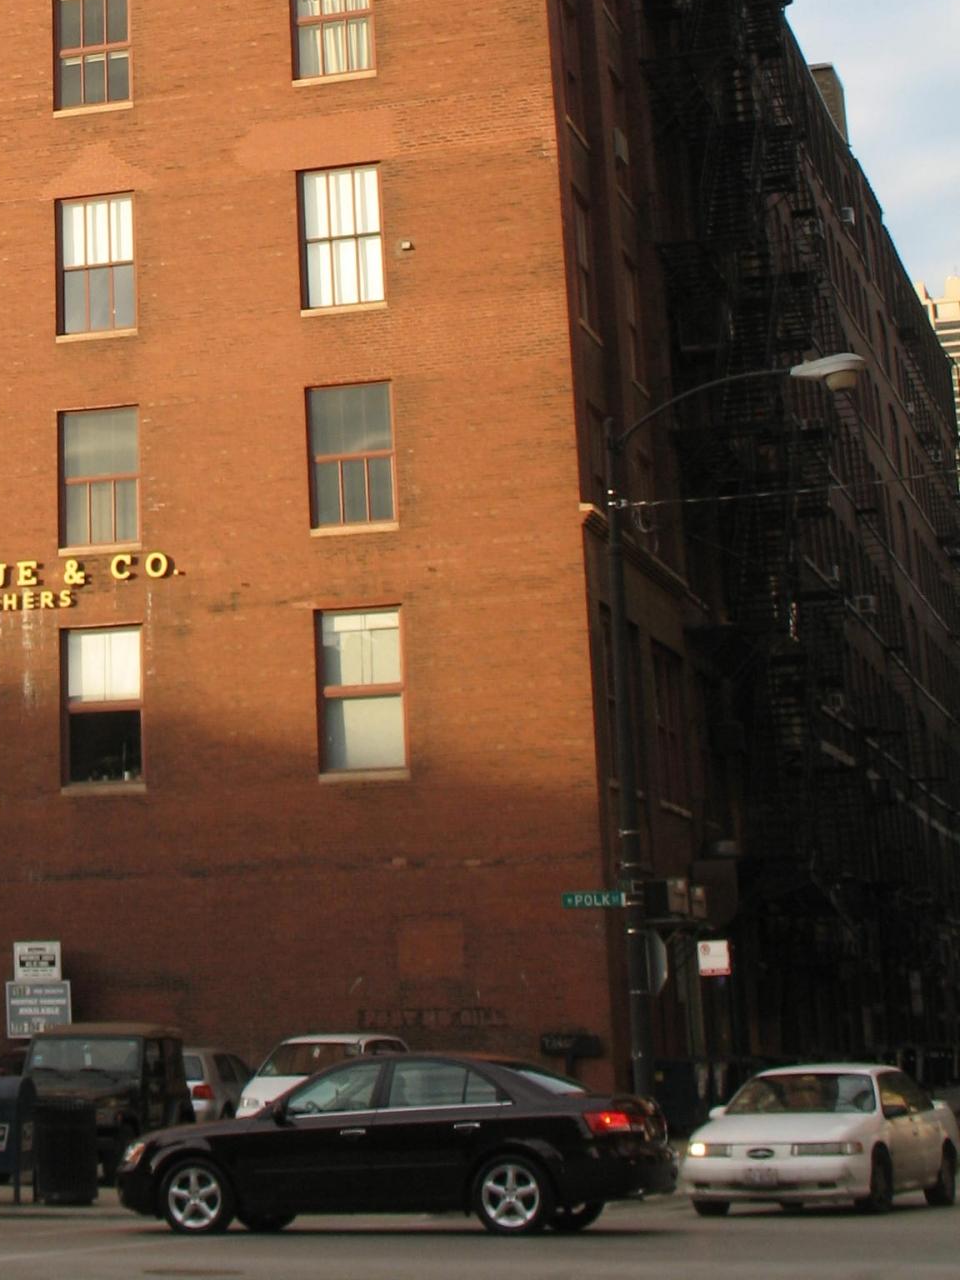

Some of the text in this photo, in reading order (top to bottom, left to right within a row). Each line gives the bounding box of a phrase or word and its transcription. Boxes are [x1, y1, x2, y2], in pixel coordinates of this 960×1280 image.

[64, 560, 85, 585] &
[111, 552, 179, 580] CO.
[574, 894, 610, 907] POLK
